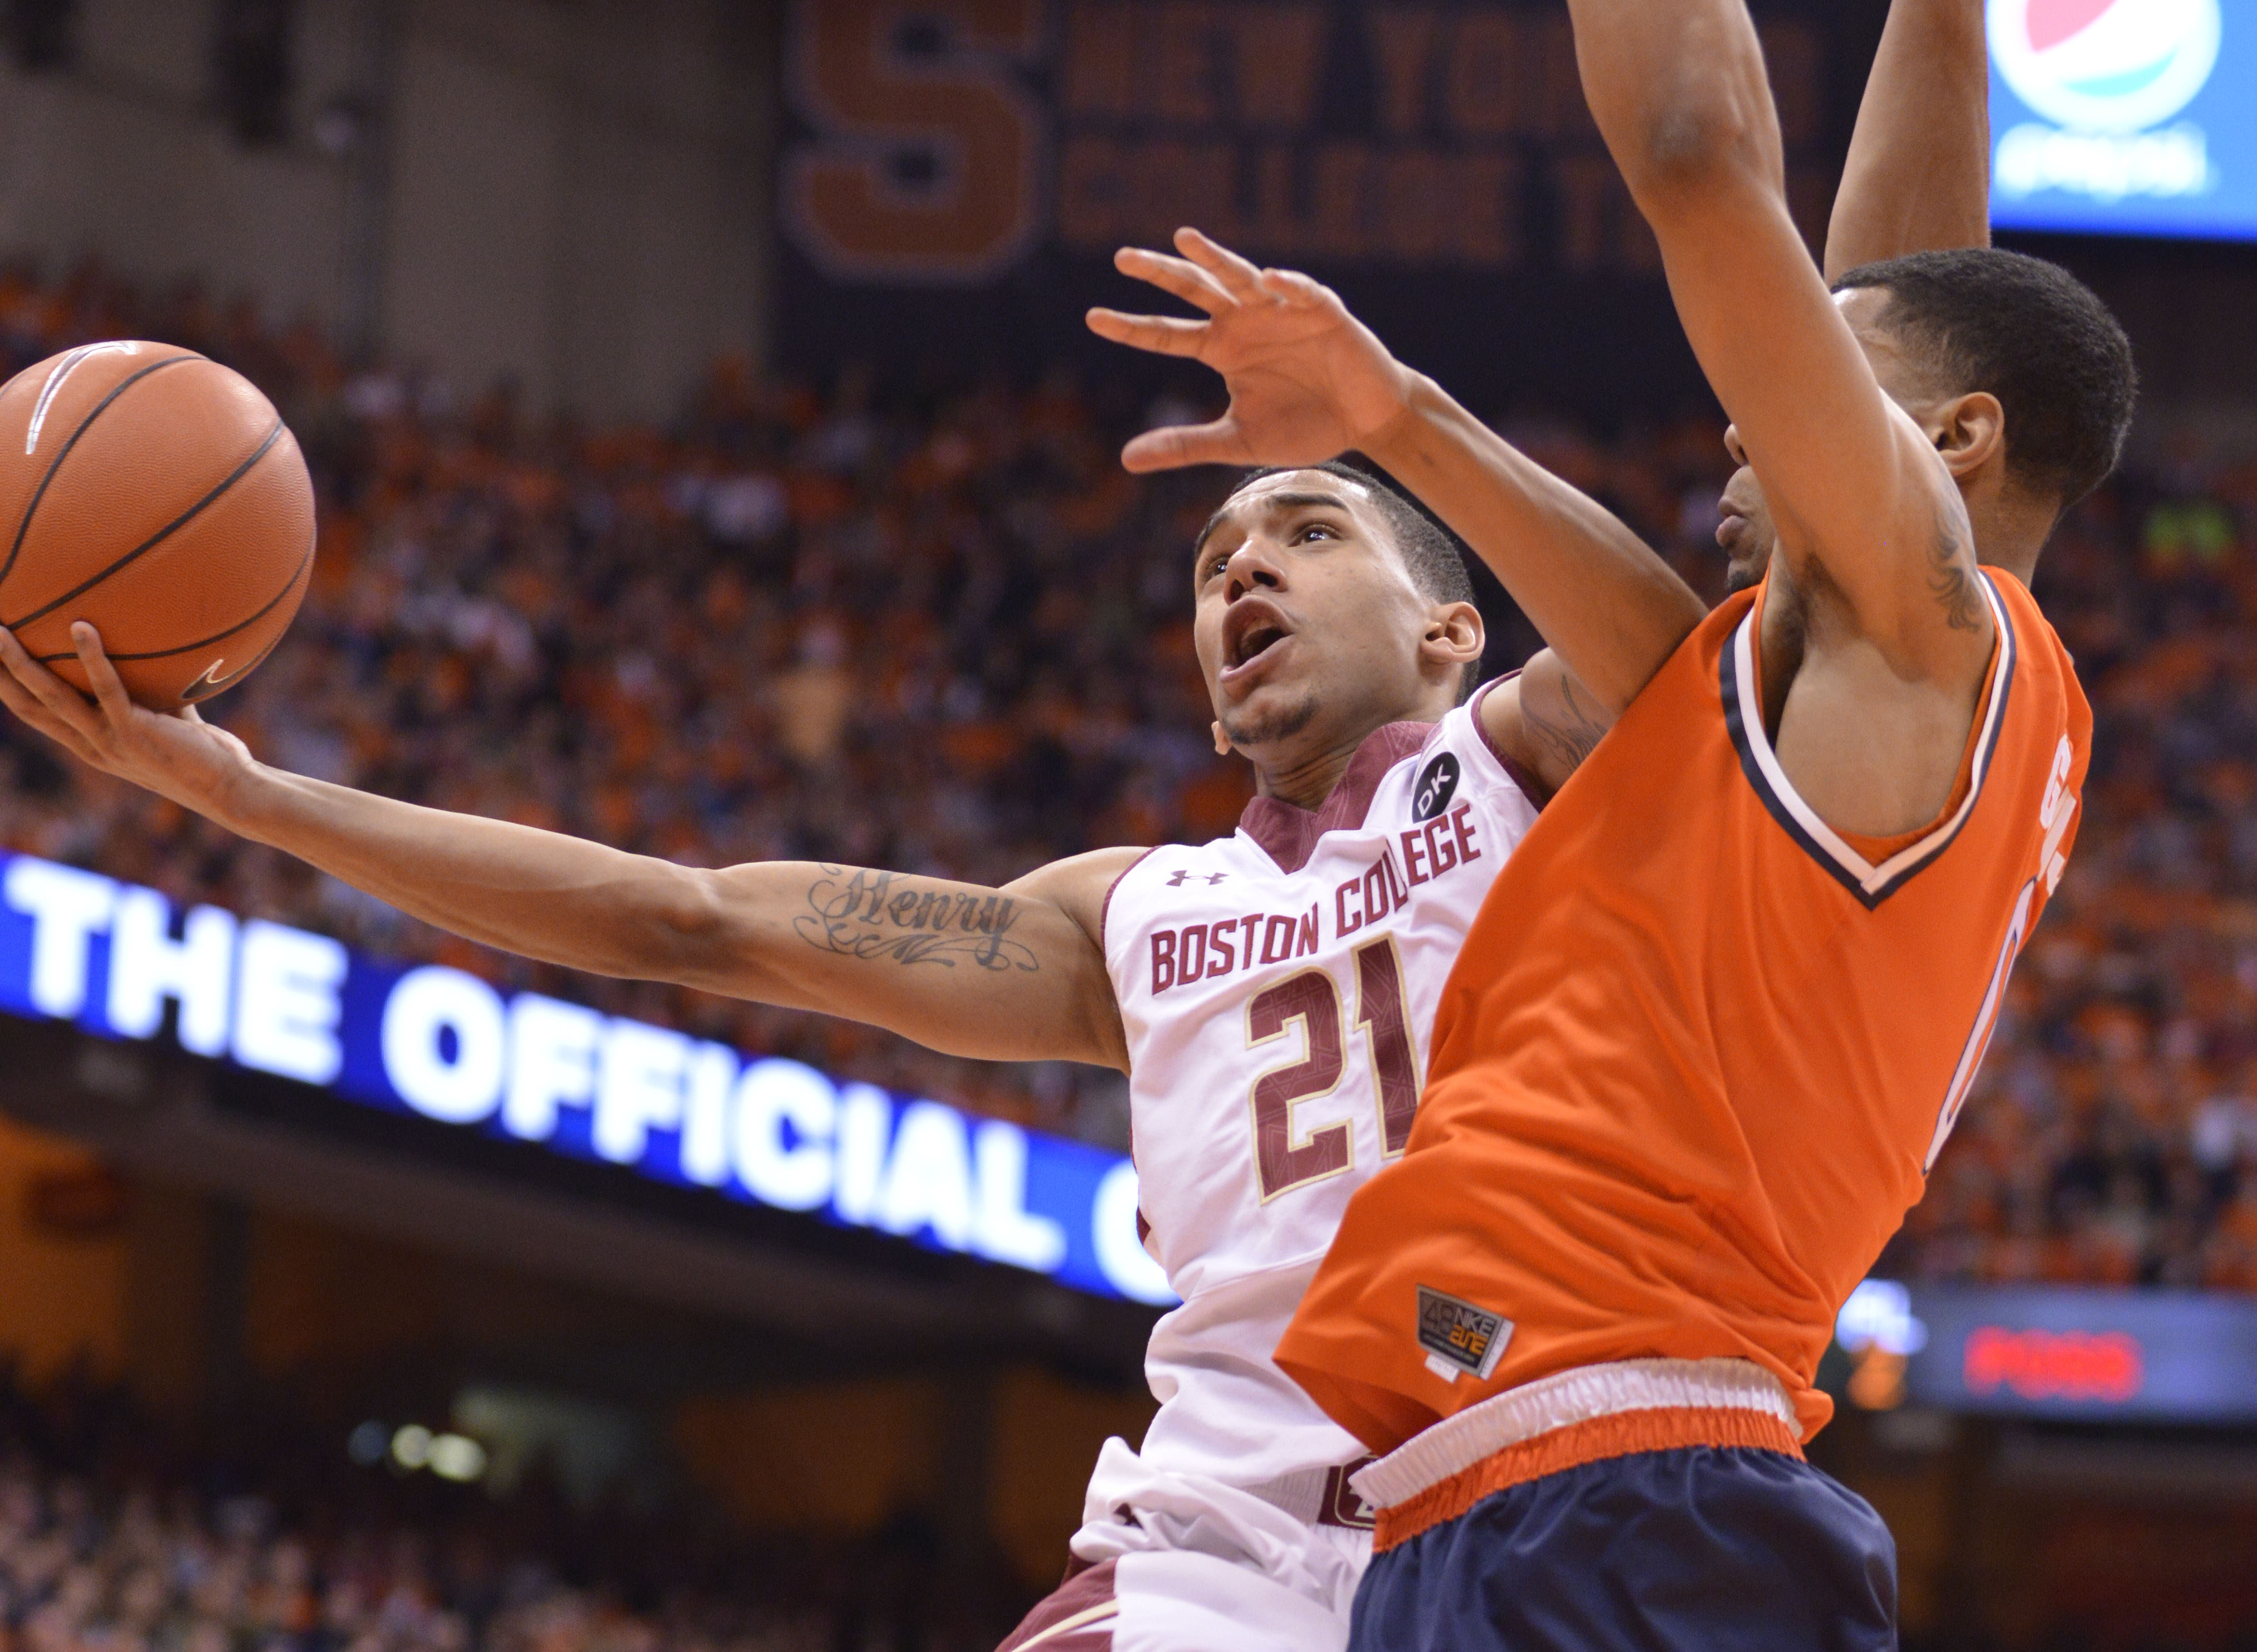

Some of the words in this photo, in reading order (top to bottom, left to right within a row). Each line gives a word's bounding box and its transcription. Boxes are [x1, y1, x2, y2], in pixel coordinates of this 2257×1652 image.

[1417, 763, 1451, 818] DK
[808, 867, 1024, 970] Henry
[1151, 901, 1319, 996] BOSTON
[1335, 803, 1482, 940] COLEGE
[3, 854, 350, 1087] THE
[381, 964, 1069, 1275] OFFICIAL
[1246, 931, 1423, 1206] 21
